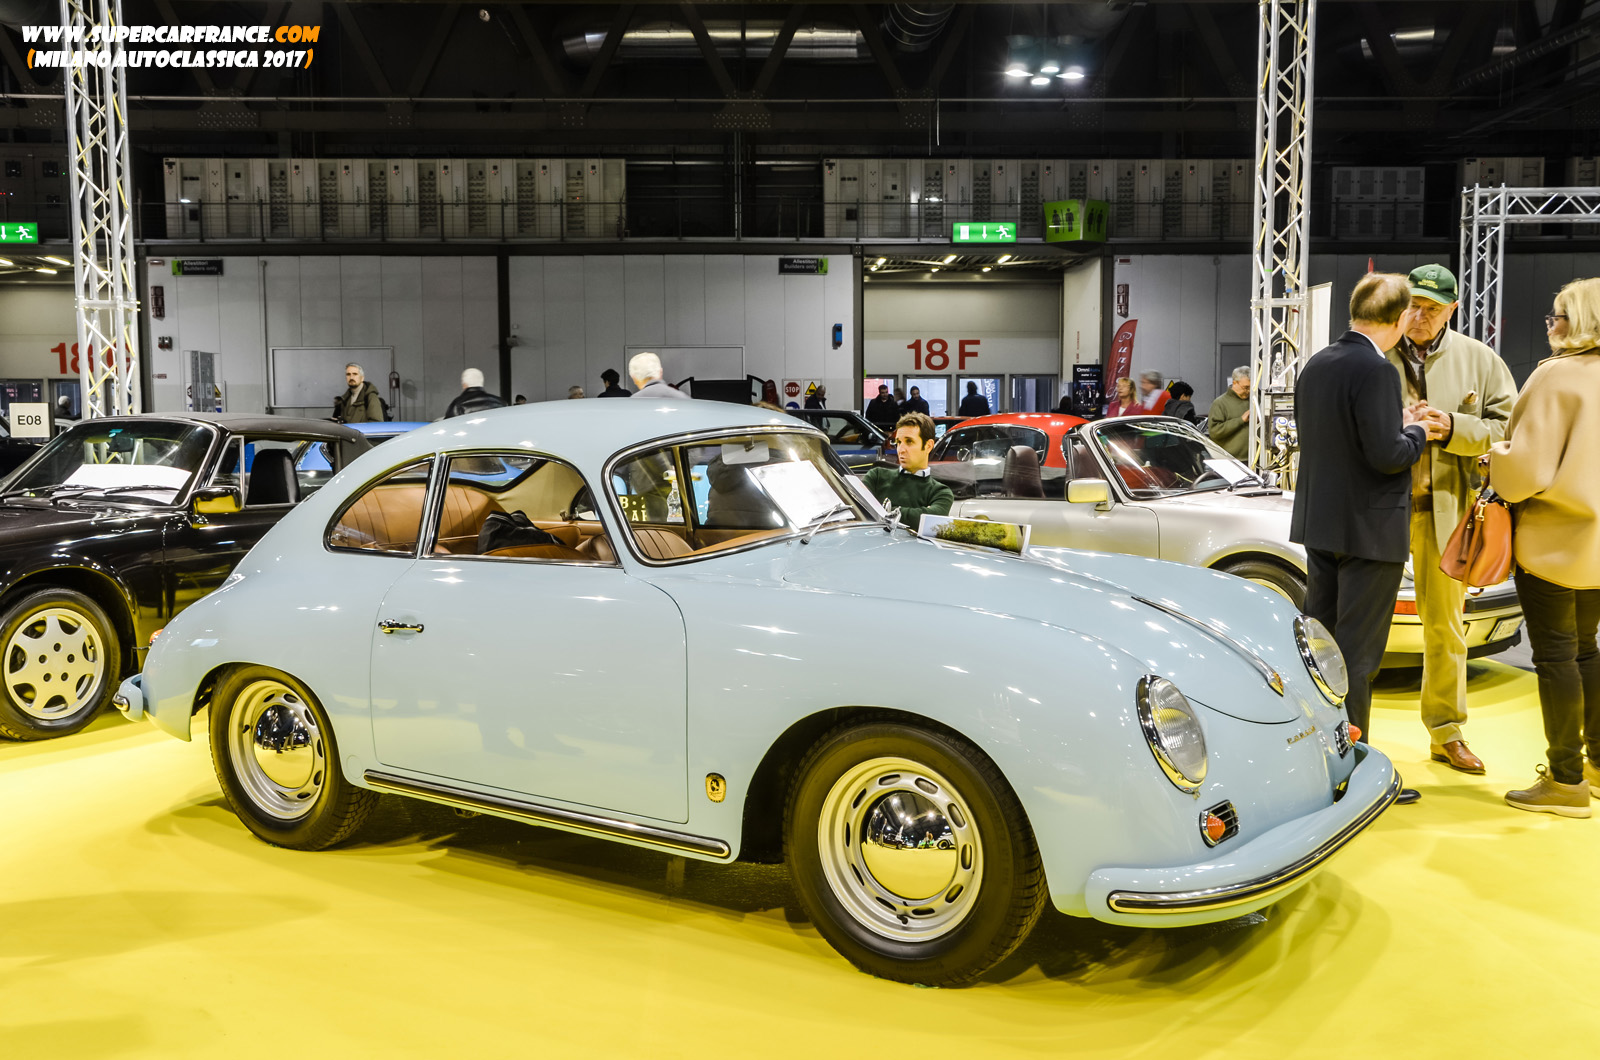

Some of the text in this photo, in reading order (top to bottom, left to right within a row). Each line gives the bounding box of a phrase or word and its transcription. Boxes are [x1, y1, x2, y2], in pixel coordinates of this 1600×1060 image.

[51, 342, 94, 375] 18
[907, 338, 981, 371] 18 F
[17, 415, 42, 425] E08
